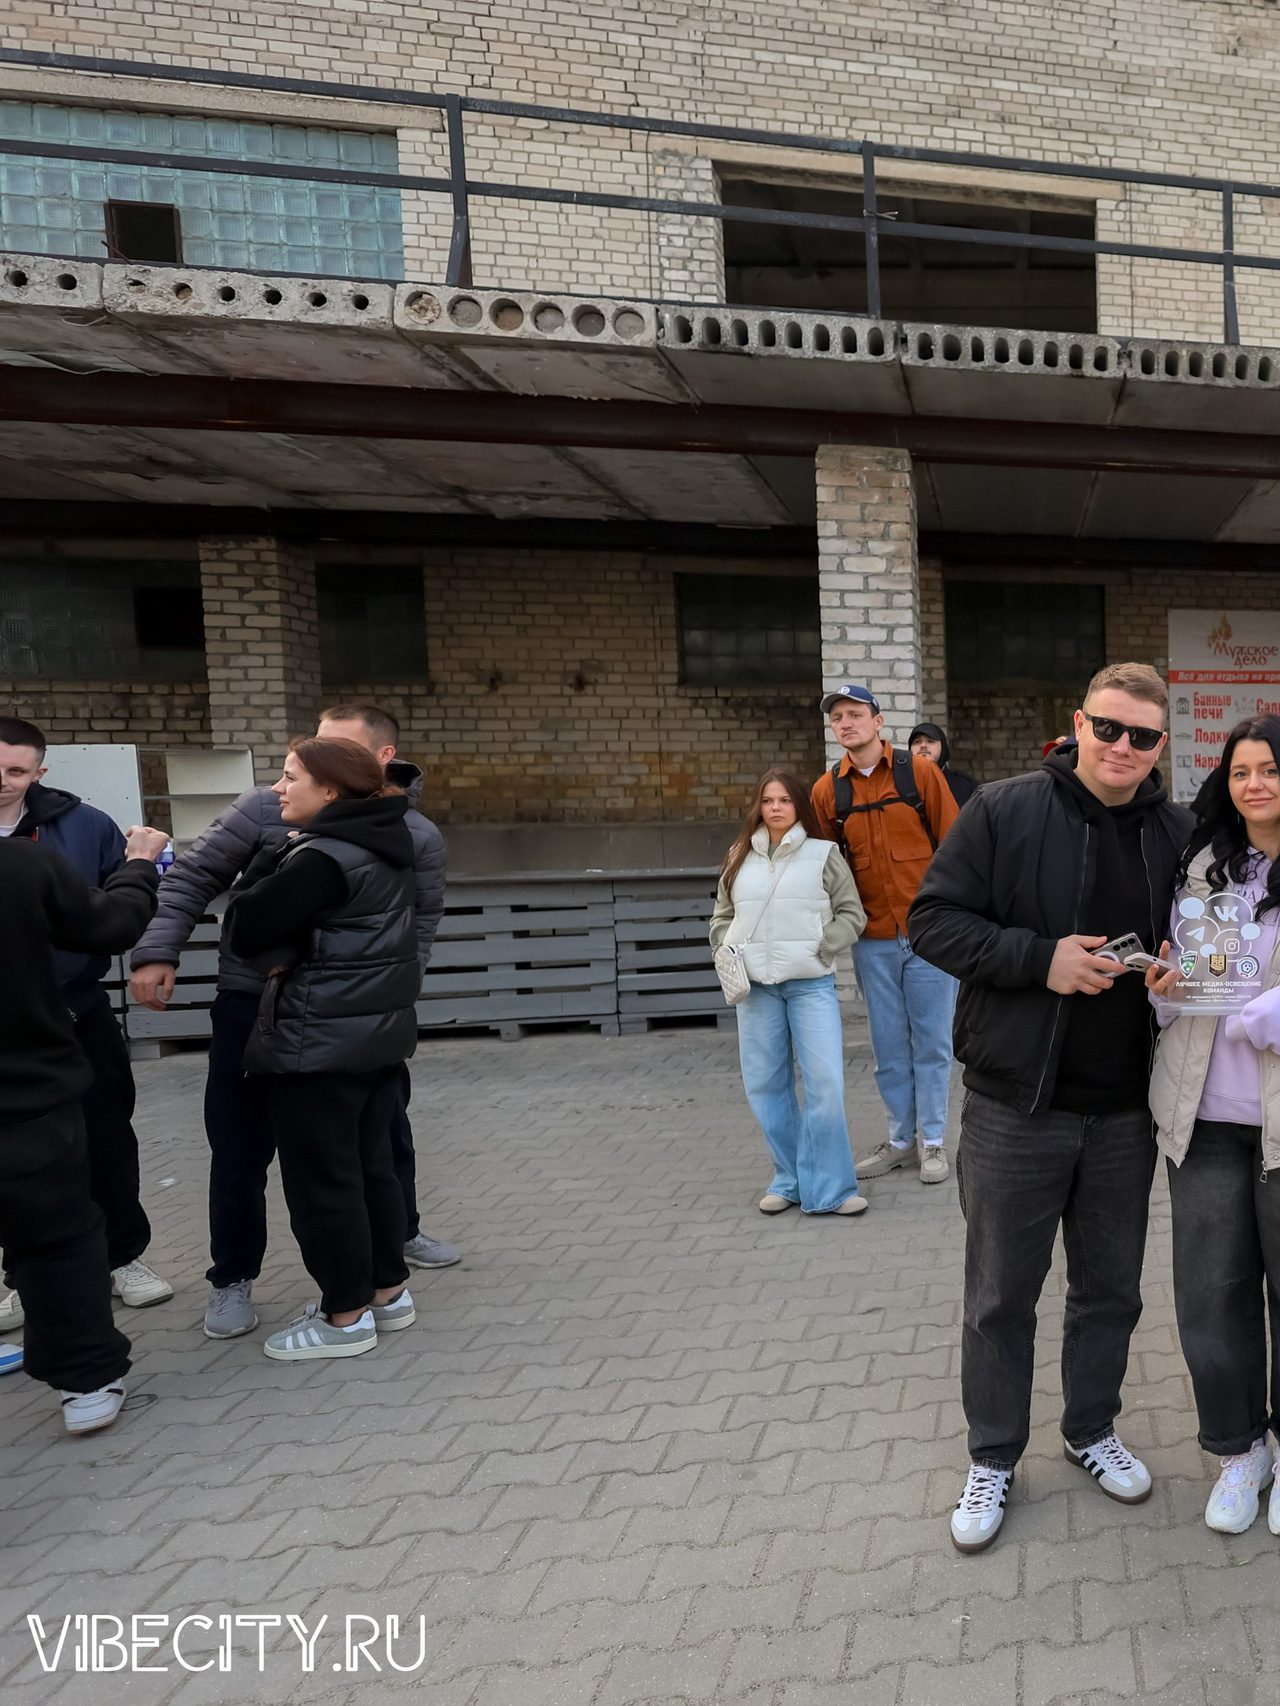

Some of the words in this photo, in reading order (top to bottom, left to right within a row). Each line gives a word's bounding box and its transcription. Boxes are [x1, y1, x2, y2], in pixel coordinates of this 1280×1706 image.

[1213, 641, 1279, 659] Мужское
[1234, 655, 1267, 669] дело
[1196, 673, 1214, 682] для
[1216, 673, 1249, 682] отдыха
[1252, 673, 1263, 681] на
[1193, 691, 1232, 707] Банные
[1194, 708, 1223, 720] печи
[1194, 728, 1230, 745] Лодки
[1194, 753, 1222, 771] Нард
